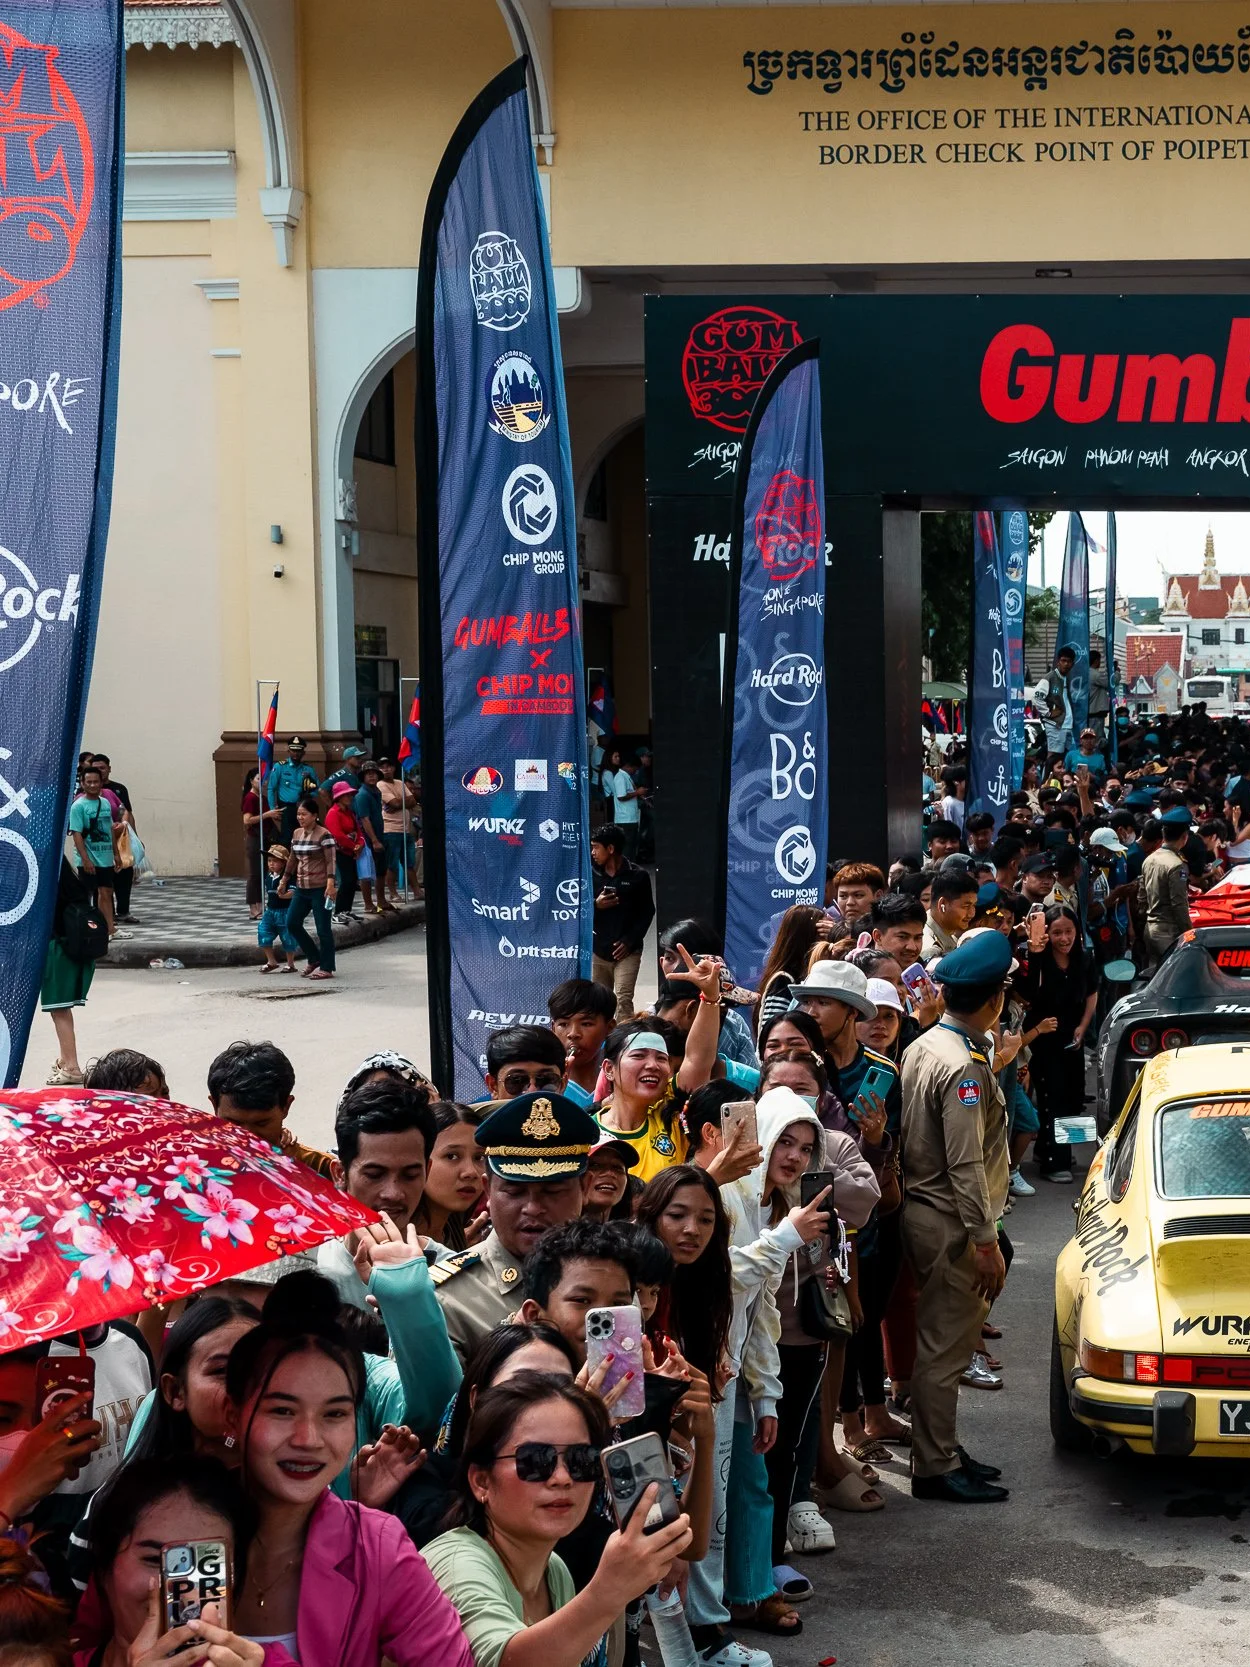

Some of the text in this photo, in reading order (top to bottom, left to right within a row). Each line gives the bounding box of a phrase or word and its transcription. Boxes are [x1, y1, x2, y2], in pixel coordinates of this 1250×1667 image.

[799, 111, 850, 131] THE
[858, 110, 947, 130] OFFICE
[954, 109, 986, 128] OF
[995, 108, 1046, 128] THE
[819, 144, 926, 164] BORDER
[936, 143, 1024, 163] CHECK
[1035, 142, 1113, 161] POINT
[1122, 141, 1154, 160] OF
[690, 321, 798, 353] GUM
[1000, 448, 1067, 468] SAIGON
[1085, 447, 1133, 468] PHNOM
[1186, 448, 1249, 477] ANGKOR
[503, 551, 564, 566] CHIP MONG
[533, 562, 564, 574] GROUP
[476, 674, 533, 697] CHIP
[751, 667, 794, 688] Hard
[467, 816, 527, 835] WURKZ
[771, 887, 819, 899] CHIP MONG
[794, 897, 819, 906] GROUP
[471, 897, 530, 921] Smart
[1082, 1217, 1150, 1297] Rock
